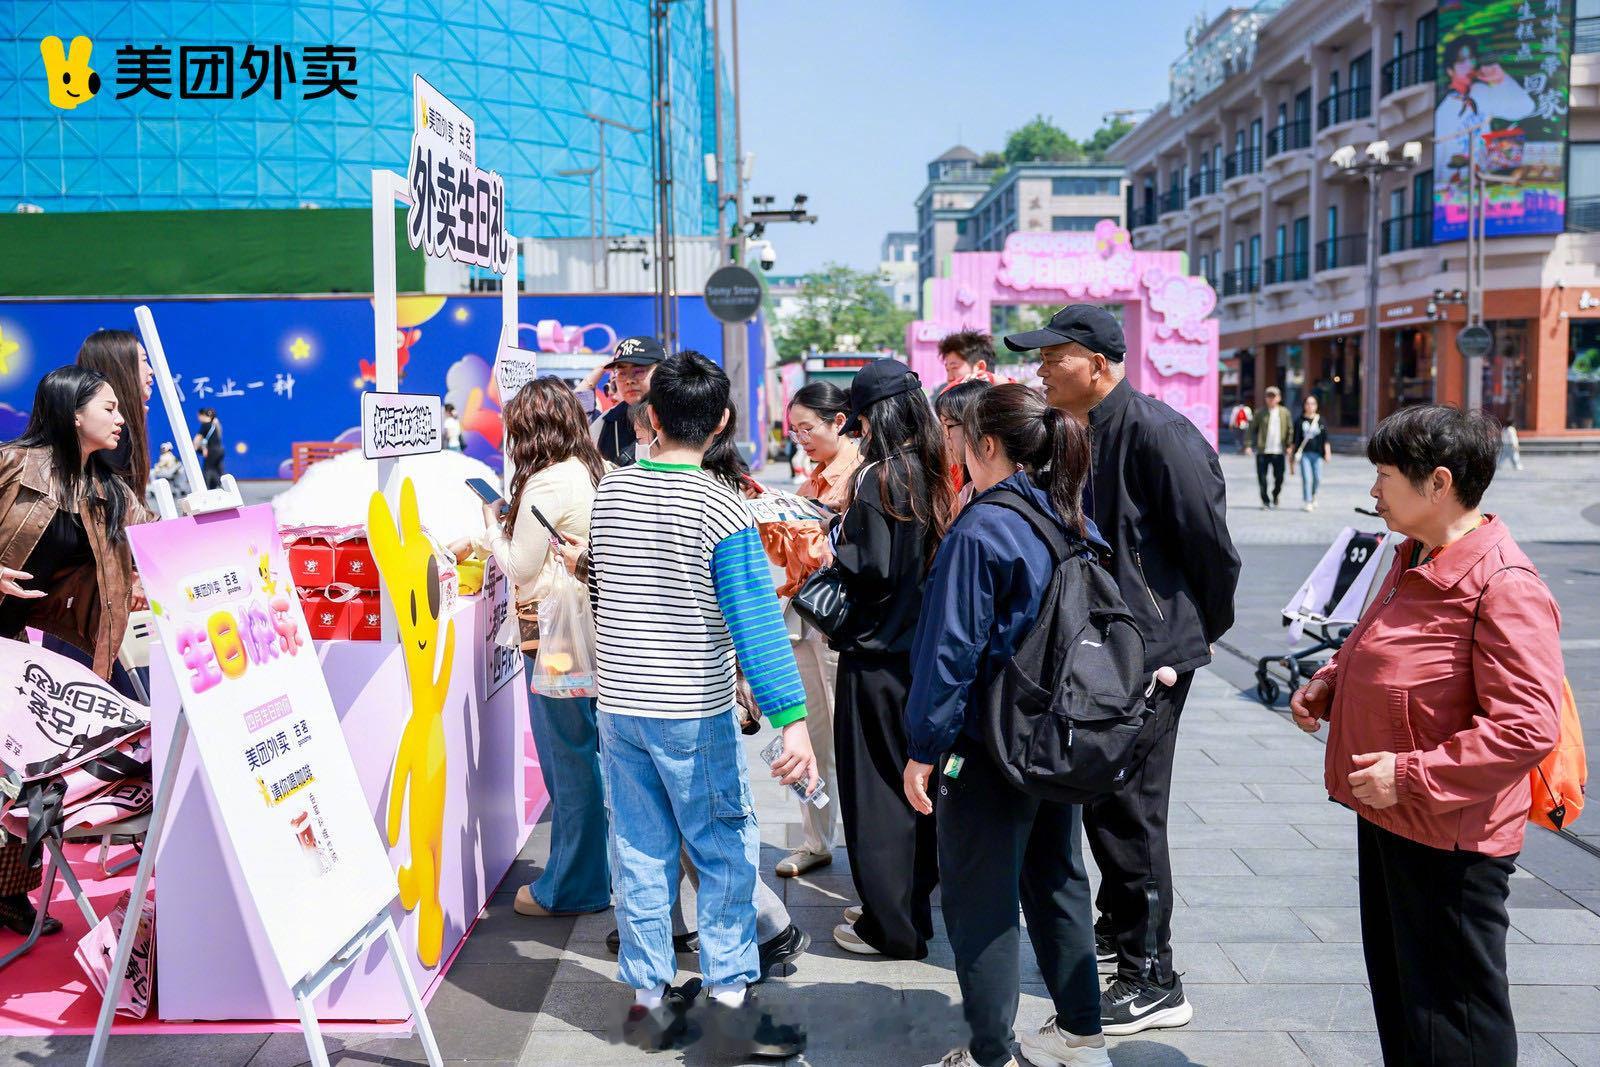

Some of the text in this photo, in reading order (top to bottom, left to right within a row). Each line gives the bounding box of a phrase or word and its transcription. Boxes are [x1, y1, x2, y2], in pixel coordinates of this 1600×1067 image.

[429, 107, 471, 150] 美团外卖 古茗
[413, 145, 509, 264] 外卖生日礼
[193, 571, 239, 599] 美团外卖 古茗
[176, 598, 303, 694] 生日快乐
[27, 689, 76, 736] 古茗
[244, 719, 308, 771] 美团外卖 古茗
